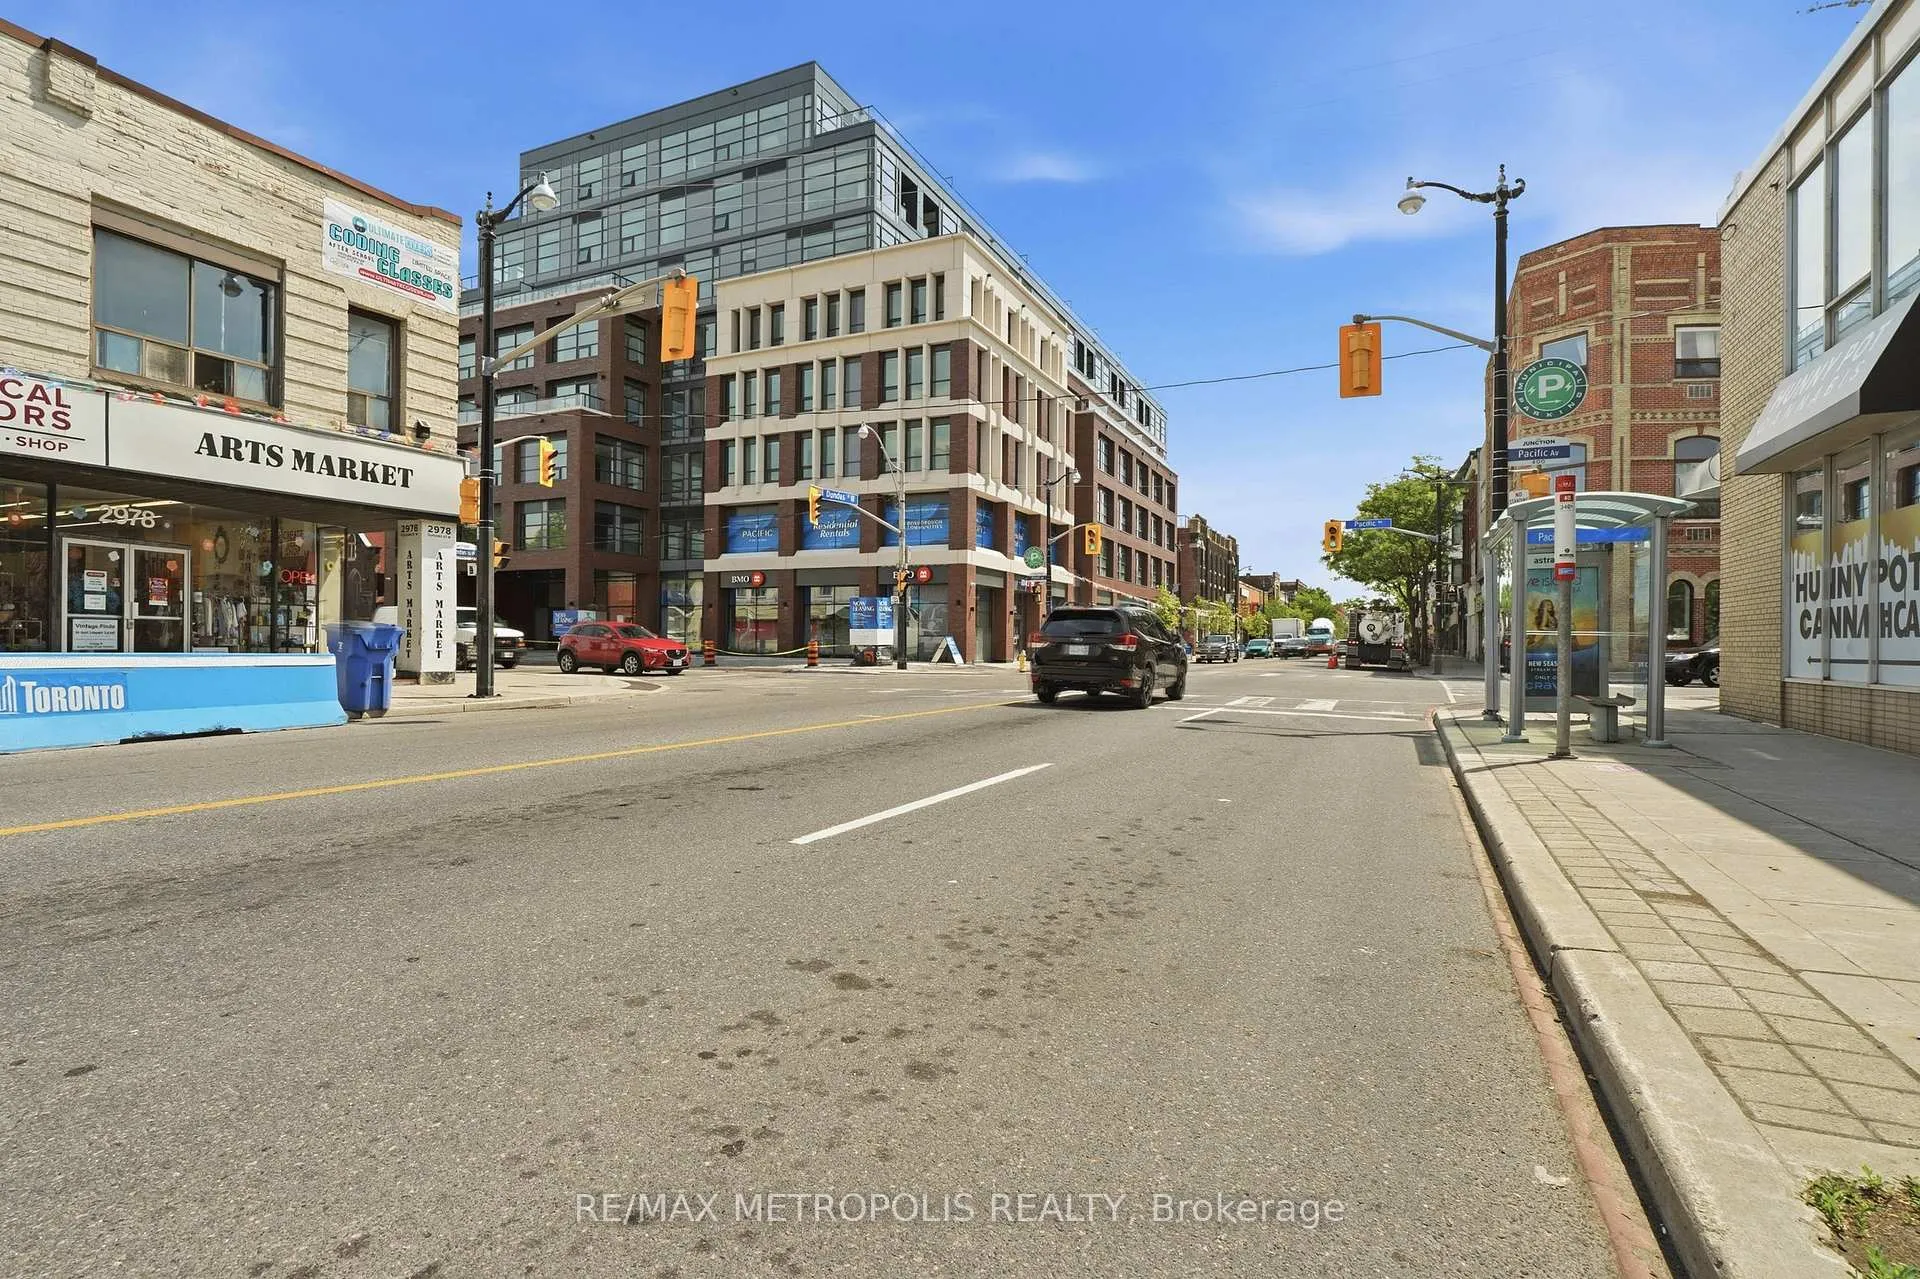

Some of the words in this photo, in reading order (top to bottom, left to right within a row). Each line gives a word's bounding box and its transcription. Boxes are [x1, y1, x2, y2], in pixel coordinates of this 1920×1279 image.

[328, 241, 349, 253] AFTER
[352, 250, 375, 262] SCHOOL
[329, 223, 400, 263] CODING
[377, 258, 453, 299] CLASSES
[1518, 361, 1582, 390] MUNICIPAL
[0, 379, 71, 409] CAL
[1539, 374, 1565, 399] P
[1518, 392, 1582, 417] PARKING
[16, 436, 68, 451] SHOP
[1518, 449, 1548, 458] Pacific
[194, 432, 283, 468] ARTS
[291, 449, 413, 488] MARKET
[826, 490, 846, 500] Dundas
[98, 504, 156, 528] 2978
[813, 519, 858, 530] Residential
[428, 525, 451, 535] 2978
[742, 529, 773, 537] PACIFIC
[820, 529, 850, 538] Rentals
[731, 575, 750, 584] BMO
[893, 571, 914, 580] BO
[20, 681, 125, 713] TORONTO
